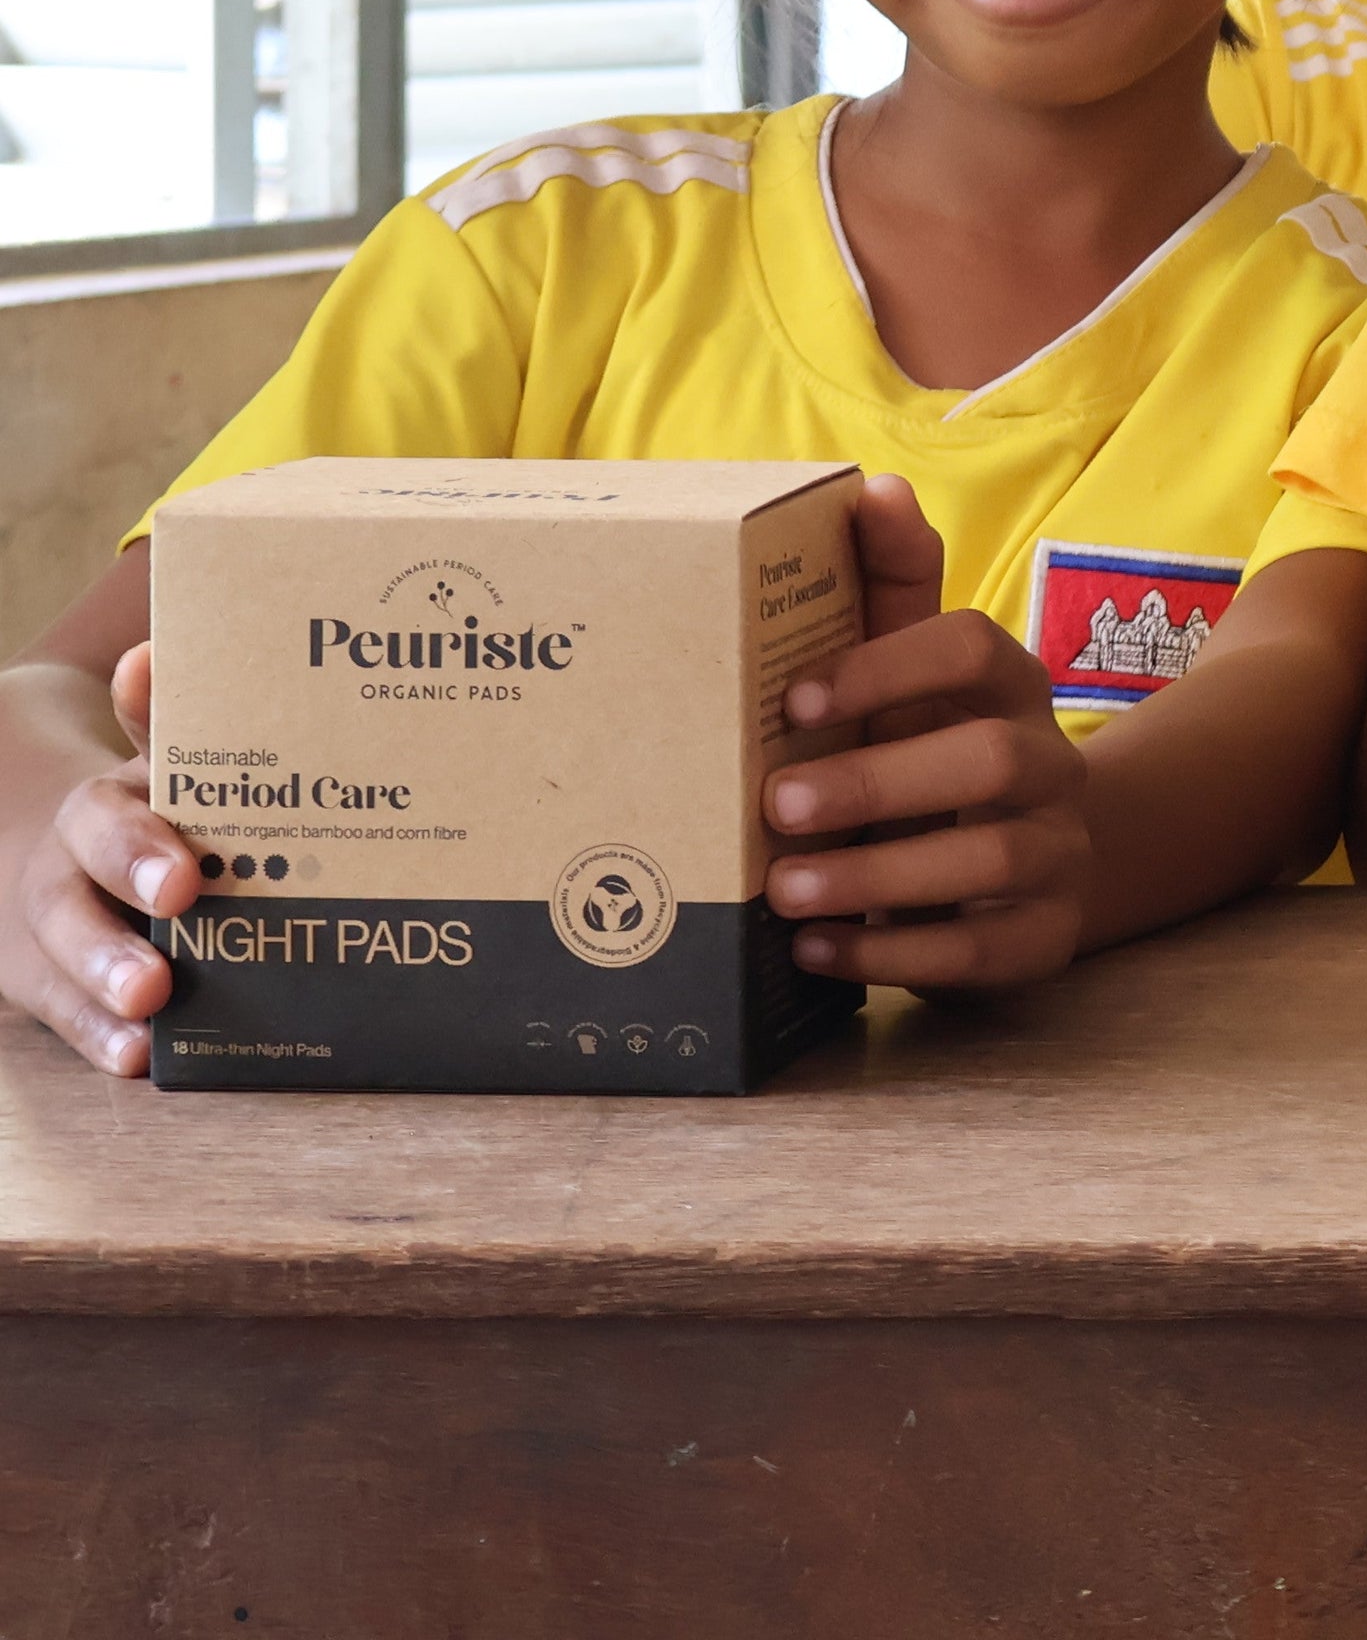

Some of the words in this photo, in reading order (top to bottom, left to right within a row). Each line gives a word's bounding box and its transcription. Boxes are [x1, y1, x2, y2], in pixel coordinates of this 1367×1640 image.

[379, 559, 438, 604] SUSTAINABLE
[444, 559, 482, 581] PERIOD
[484, 579, 503, 607] CARE
[361, 684, 457, 701] ORGANIC
[469, 685, 521, 701] PADS
[166, 746, 278, 767] Sustainable
[169, 772, 300, 808] Period
[311, 776, 411, 810] Care
[211, 823, 241, 837] with
[244, 825, 298, 840] organic
[302, 825, 363, 840] bamboo
[365, 827, 393, 840] and
[396, 829, 431, 840] corn
[434, 827, 467, 840] fibre
[170, 916, 327, 963] NIGHT
[337, 918, 473, 966] PADS
[172, 1041, 187, 1055] 18
[190, 1042, 254, 1056] Ultra-thin
[257, 1043, 294, 1059] Night
[296, 1043, 332, 1058] Pads
